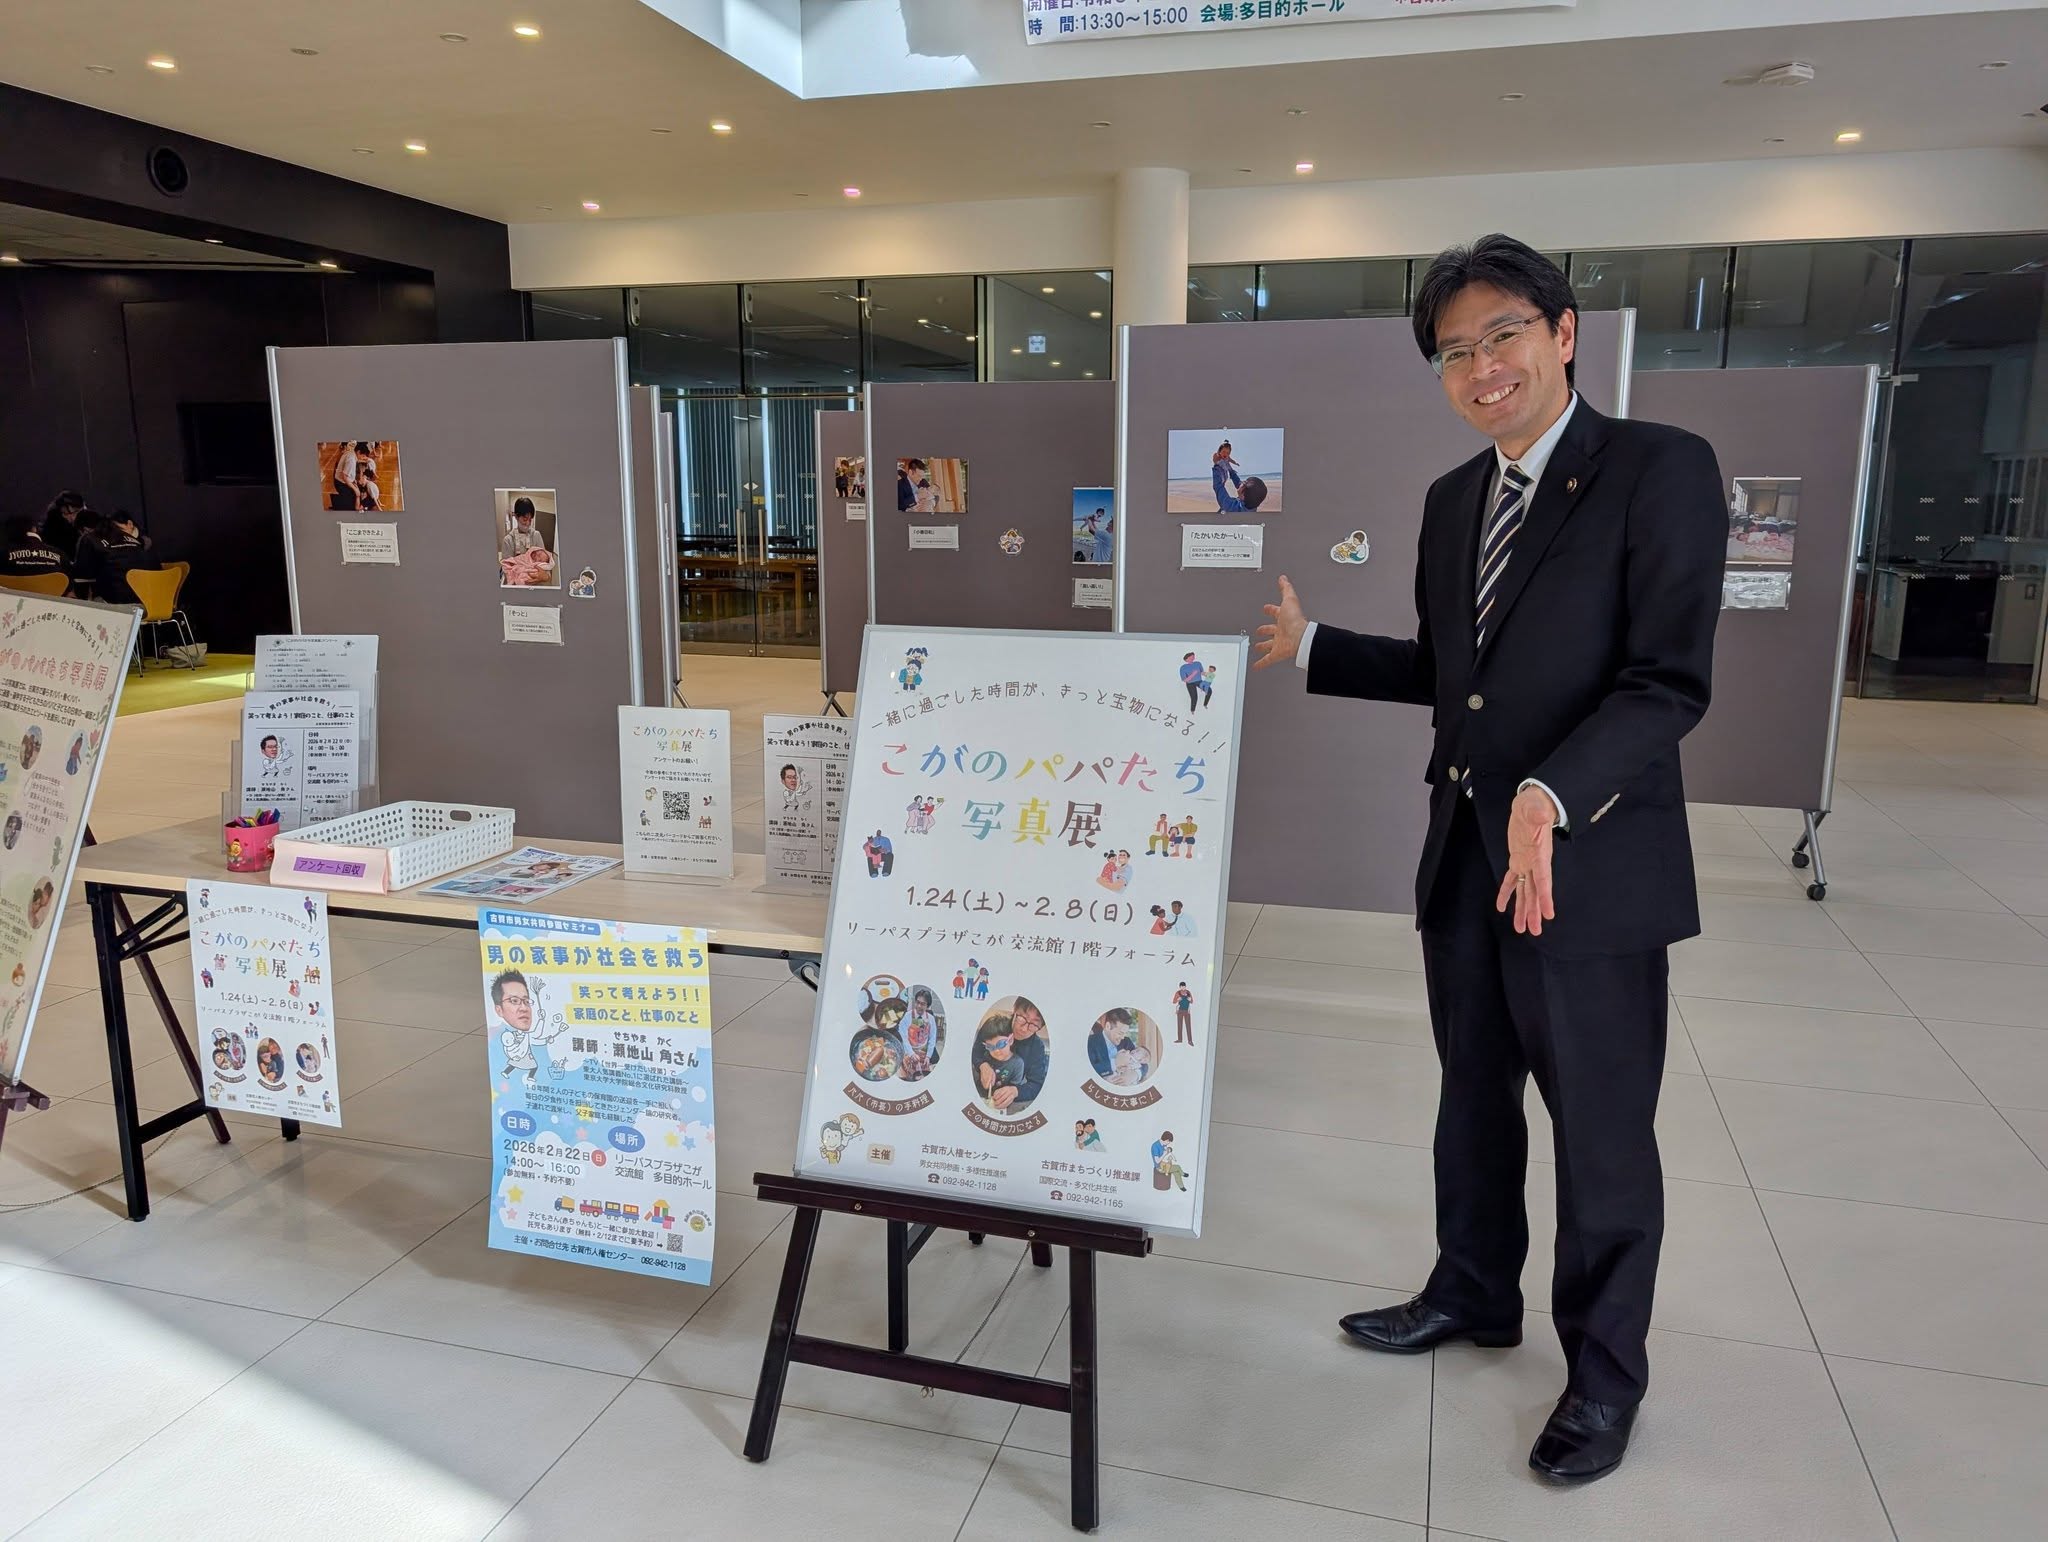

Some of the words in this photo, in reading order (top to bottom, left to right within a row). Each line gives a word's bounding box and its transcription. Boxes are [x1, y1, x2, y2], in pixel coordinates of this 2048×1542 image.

[1028, 19, 1042, 36] 時
[1190, 531, 1244, 540] 「たかいたかーい」
[633, 726, 719, 740] こがのパパたち
[656, 740, 693, 753] 写真展
[882, 743, 1207, 795] こがのパパたち
[962, 796, 1104, 850] 写真展
[299, 859, 361, 876] アンケート回収
[200, 931, 321, 958] こがのパパたち
[487, 944, 704, 968] 男の家事が社会を救う
[235, 956, 287, 979] 写真展
[613, 1031, 647, 1043] せちやま
[657, 1036, 673, 1047] かく
[660, 1051, 700, 1069] 角さん
[506, 1116, 531, 1131] 日時
[967, 1108, 1041, 1134] この時間が力になる
[614, 1131, 640, 1147] 場所
[870, 1148, 891, 1161] 主催
[921, 1143, 998, 1161] 古賀市人権センター
[550, 1162, 581, 1176] 16:00
[1041, 1160, 1140, 1182] 古賀市まちづくり推進課
[615, 1167, 644, 1181] 交流館
[653, 1172, 712, 1190] 多目的ホール
[942, 1176, 997, 1191] 092-942-1128
[1039, 1175, 1118, 1194] 国際交流・多文化共生係
[1066, 1192, 1124, 1208] 092-942-1165
[570, 1243, 635, 1262] 古賀市人権センター
[641, 1256, 687, 1271] 092-942-1128
